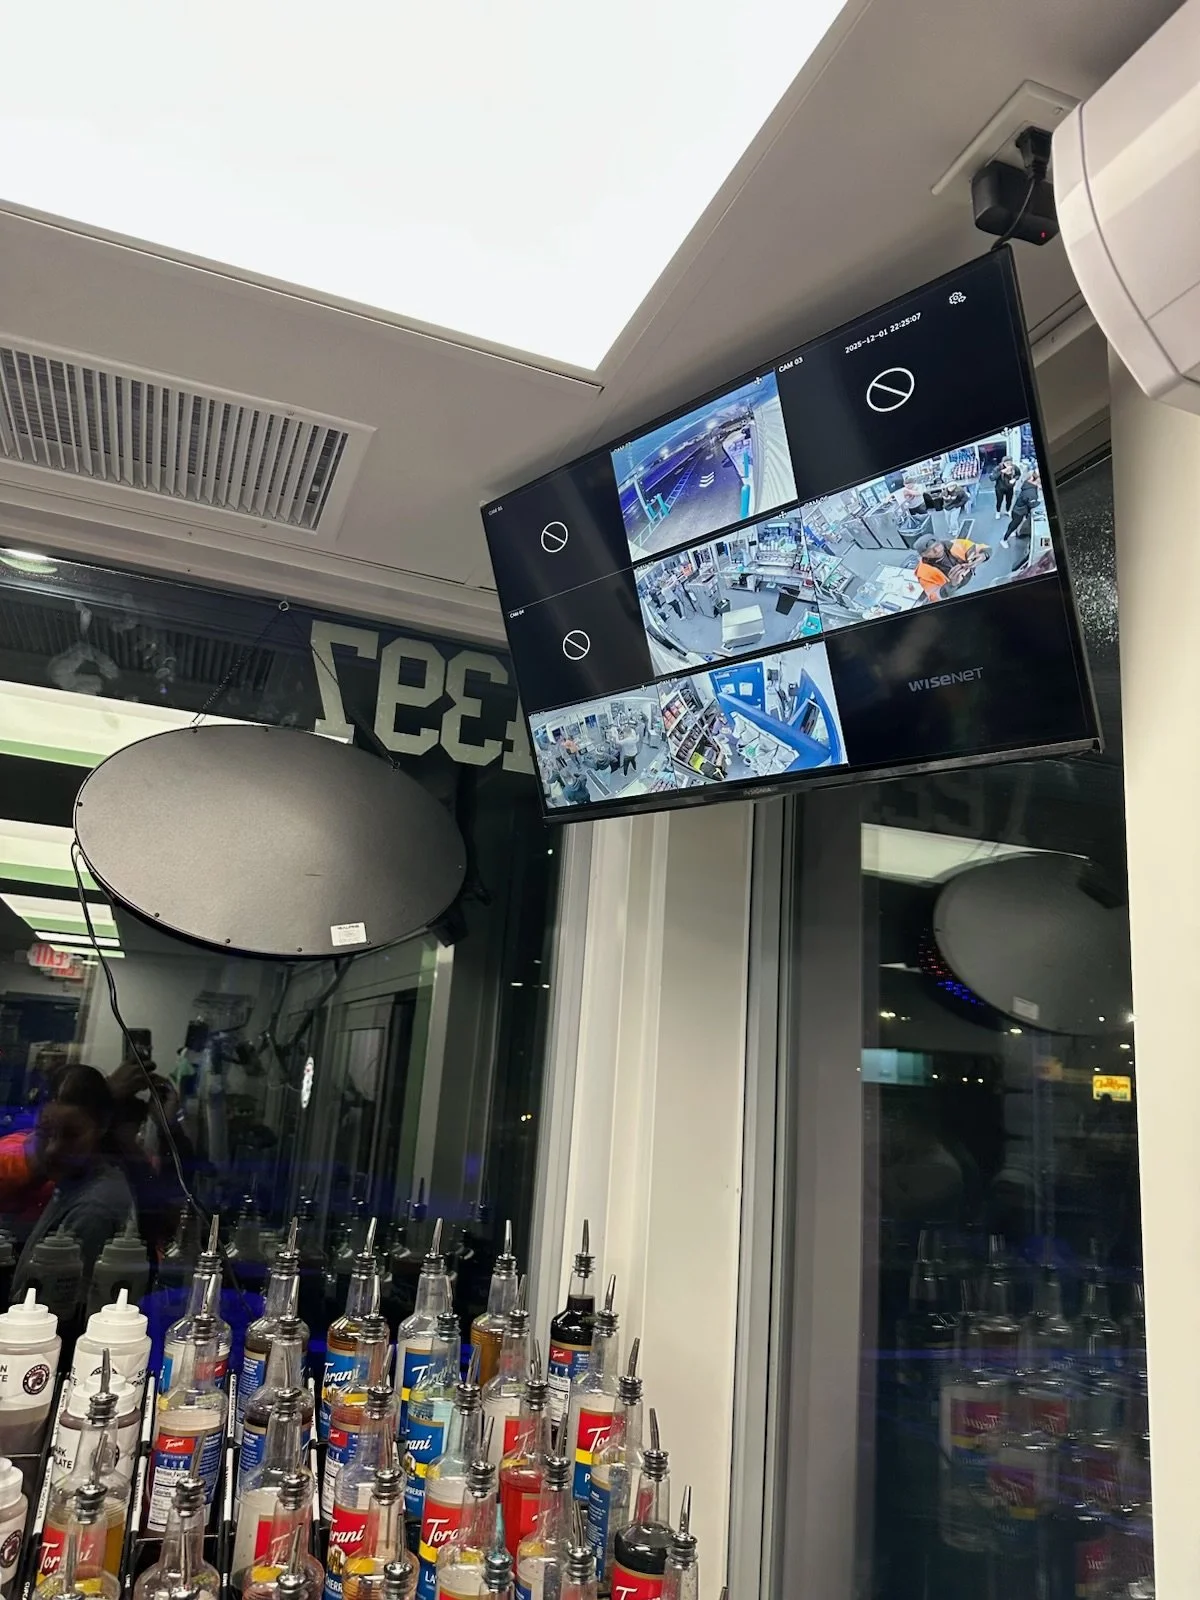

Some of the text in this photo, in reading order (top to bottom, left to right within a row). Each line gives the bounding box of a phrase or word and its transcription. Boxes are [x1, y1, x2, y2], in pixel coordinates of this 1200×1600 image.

[844, 312, 921, 354] 2025-12-01 22:25:07
[778, 357, 804, 373] CAM 03
[509, 611, 519, 619] CAM
[406, 1431, 433, 1450] rani
[325, 1579, 343, 1592] HERR
